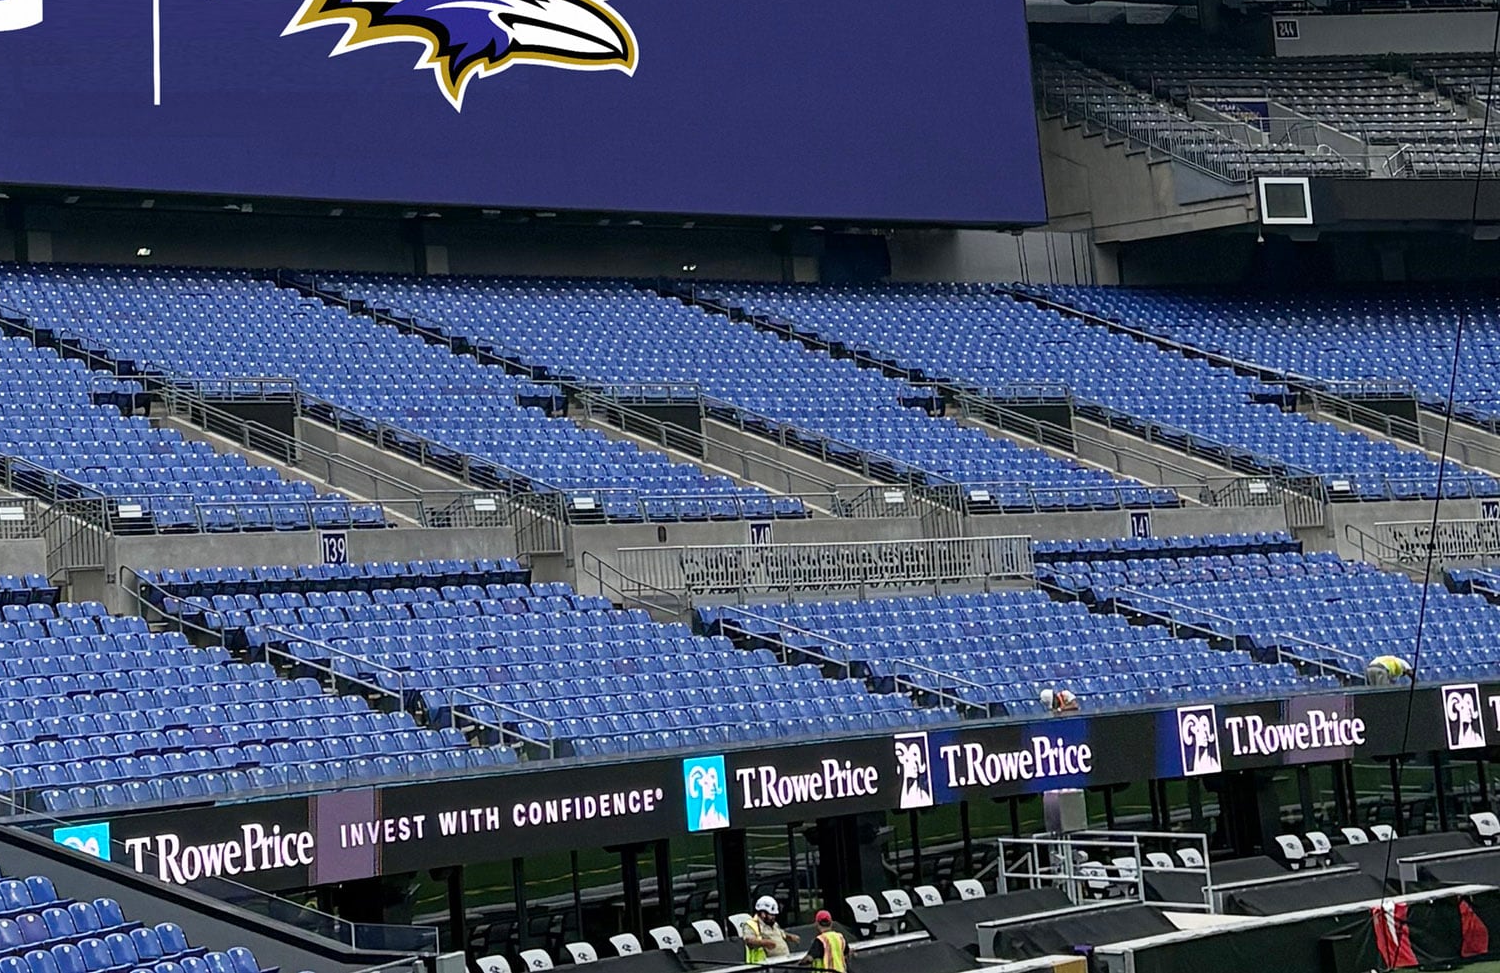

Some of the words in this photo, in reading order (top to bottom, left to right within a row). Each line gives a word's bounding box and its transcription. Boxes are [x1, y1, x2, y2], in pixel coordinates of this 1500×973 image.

[1133, 516, 1149, 537] 141
[323, 537, 345, 563] 139
[340, 815, 426, 848] INVEST
[438, 807, 500, 836] WITH
